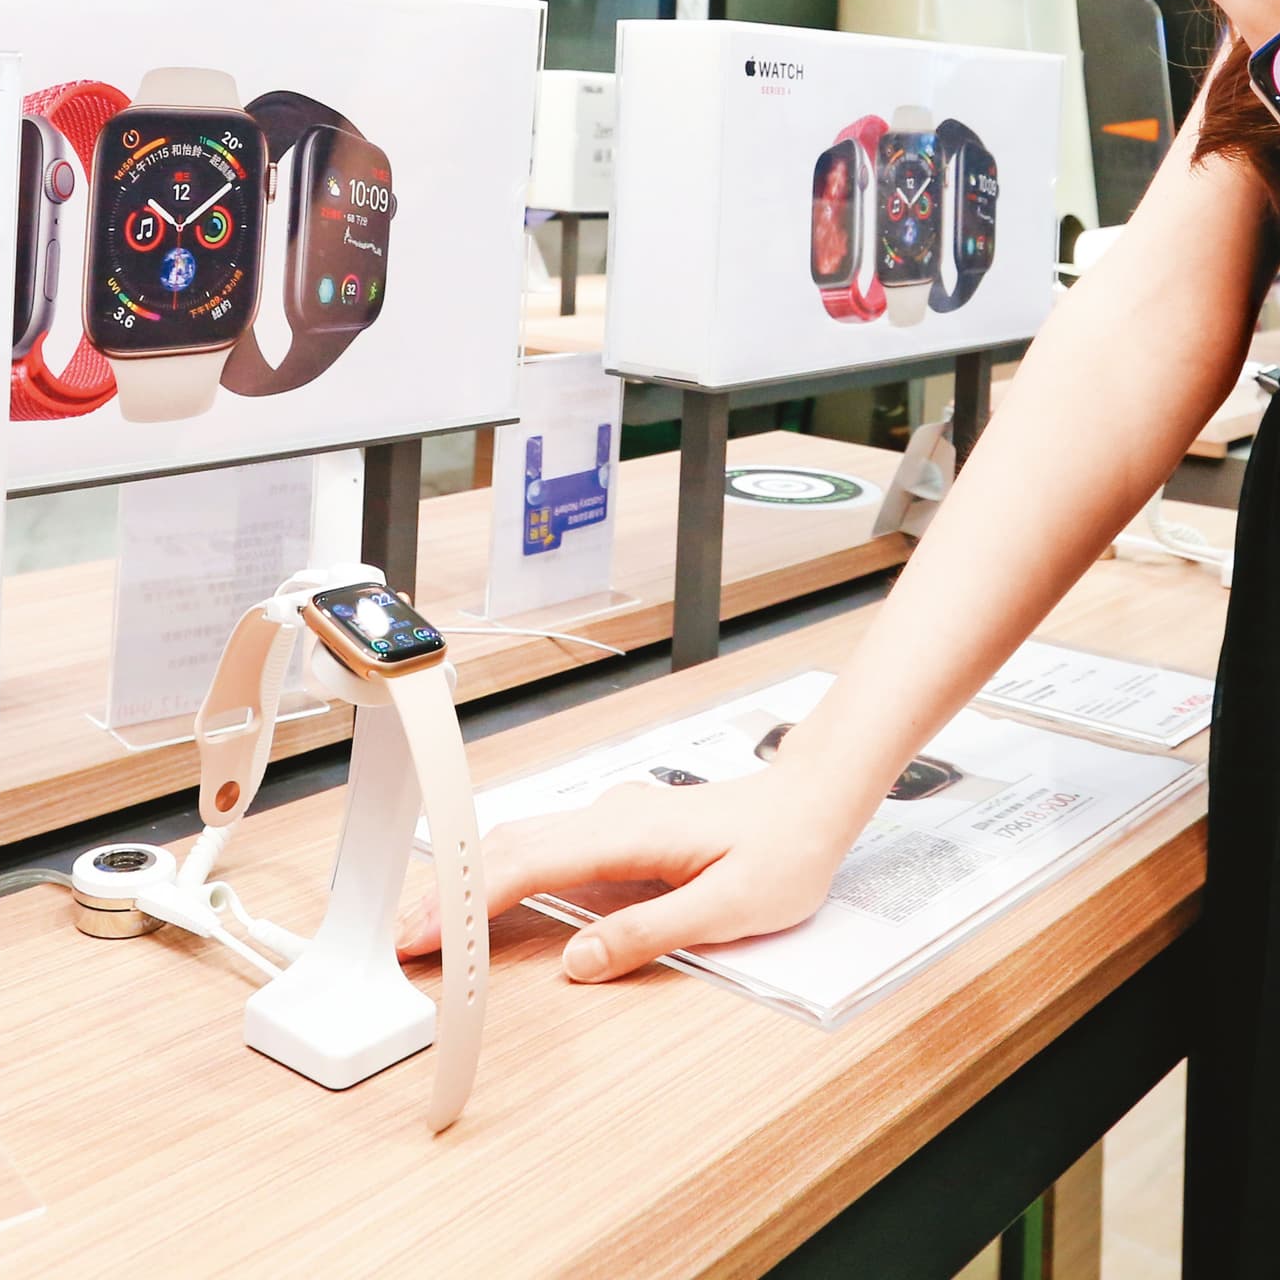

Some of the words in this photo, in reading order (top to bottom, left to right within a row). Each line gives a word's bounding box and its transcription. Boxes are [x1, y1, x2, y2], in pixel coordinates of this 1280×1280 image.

[758, 61, 804, 80] WATCH
[221, 131, 244, 151] 20°
[114, 158, 134, 181] 14:59
[172, 183, 191, 201] 12
[349, 178, 389, 214] 10:09
[346, 283, 356, 296] 32
[112, 307, 136, 329] 3.6
